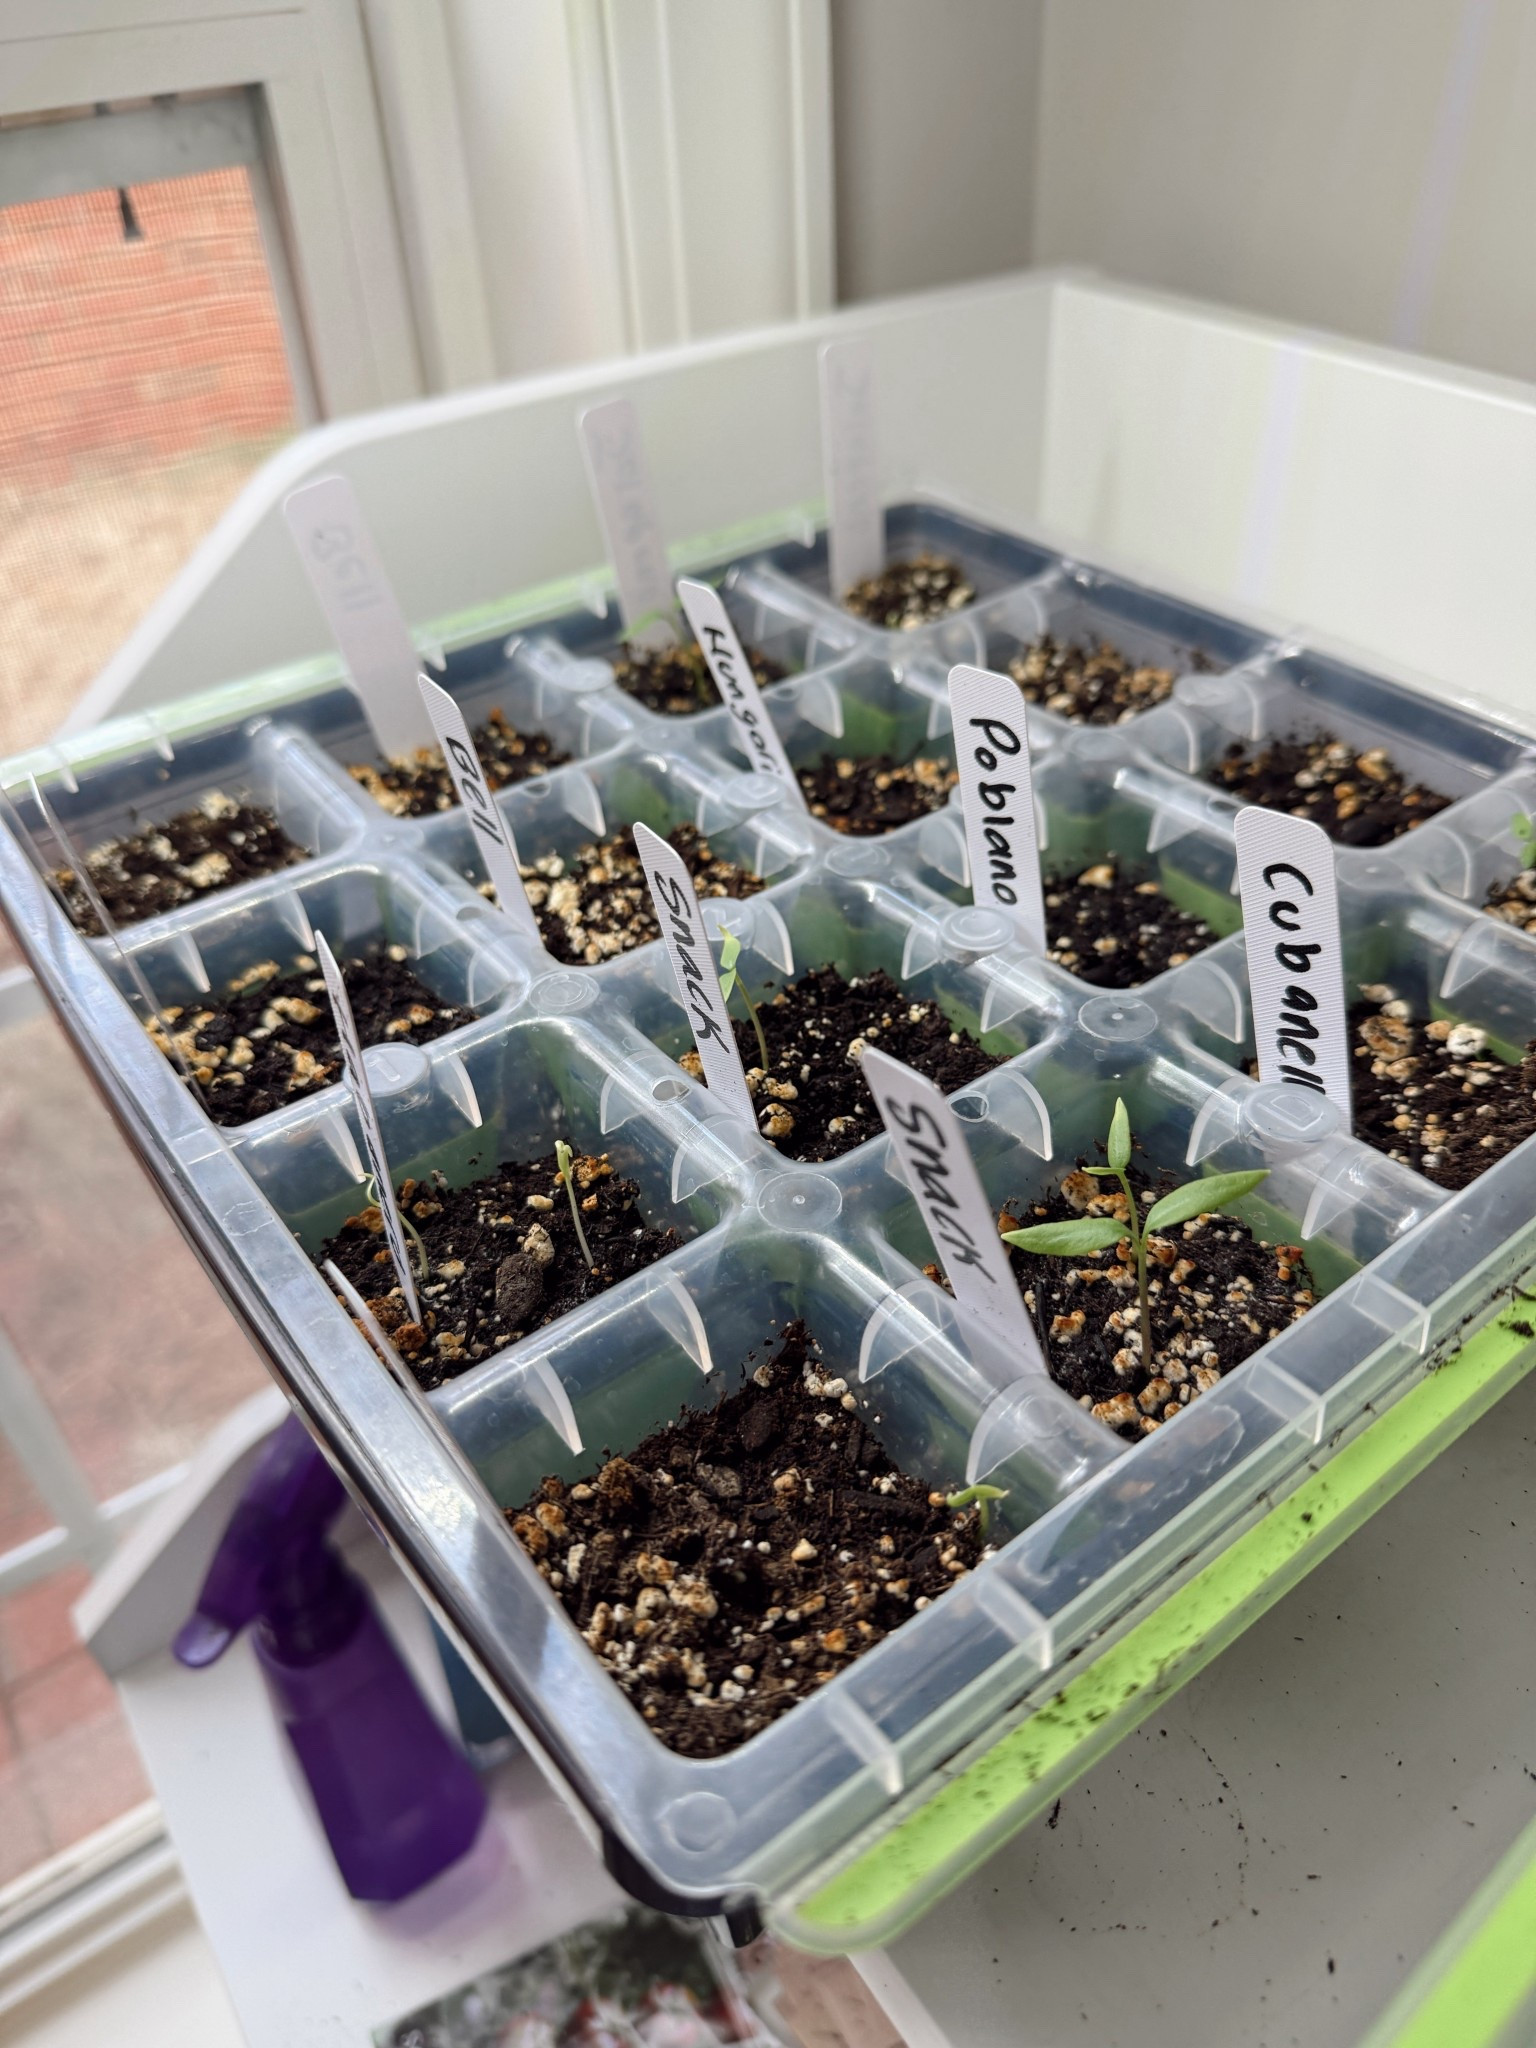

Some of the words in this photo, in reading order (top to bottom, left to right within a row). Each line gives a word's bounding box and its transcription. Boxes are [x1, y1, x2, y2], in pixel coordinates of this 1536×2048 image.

[446, 736, 504, 846] Bell
[703, 626, 785, 775] Hungari
[969, 718, 1021, 906] Poblano
[654, 870, 731, 1054] Snack
[1262, 862, 1326, 1095] Cubanell
[886, 1097, 997, 1284] Snack
